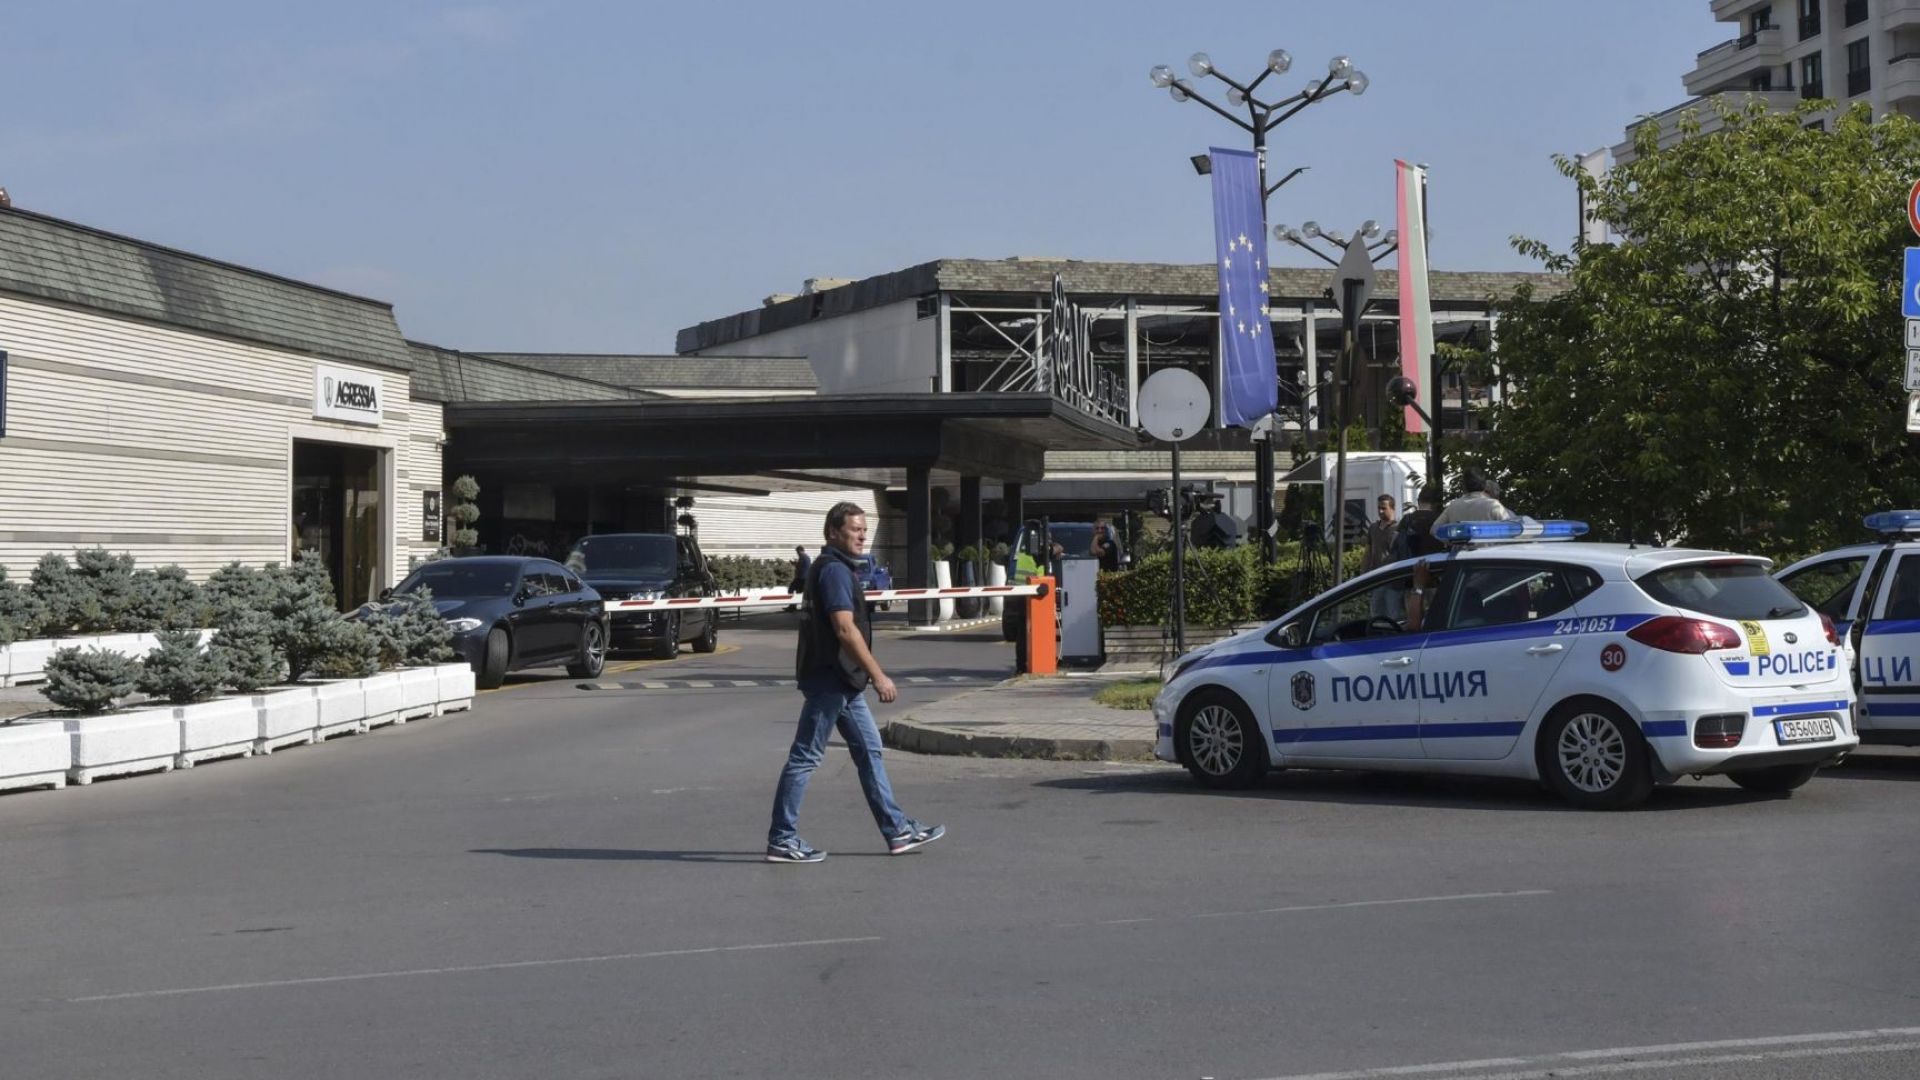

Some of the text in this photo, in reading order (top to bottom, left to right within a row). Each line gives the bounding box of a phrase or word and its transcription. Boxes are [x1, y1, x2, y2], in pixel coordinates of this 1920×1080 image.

[336, 380, 377, 409] AGRESSIA
[1553, 616, 1617, 635] 24-1051
[1603, 650, 1623, 666] 30
[1758, 650, 1824, 676] POLICE
[1865, 655, 1912, 687] ЦИ
[1331, 670, 1488, 703] ПОЛИЦИЯ
